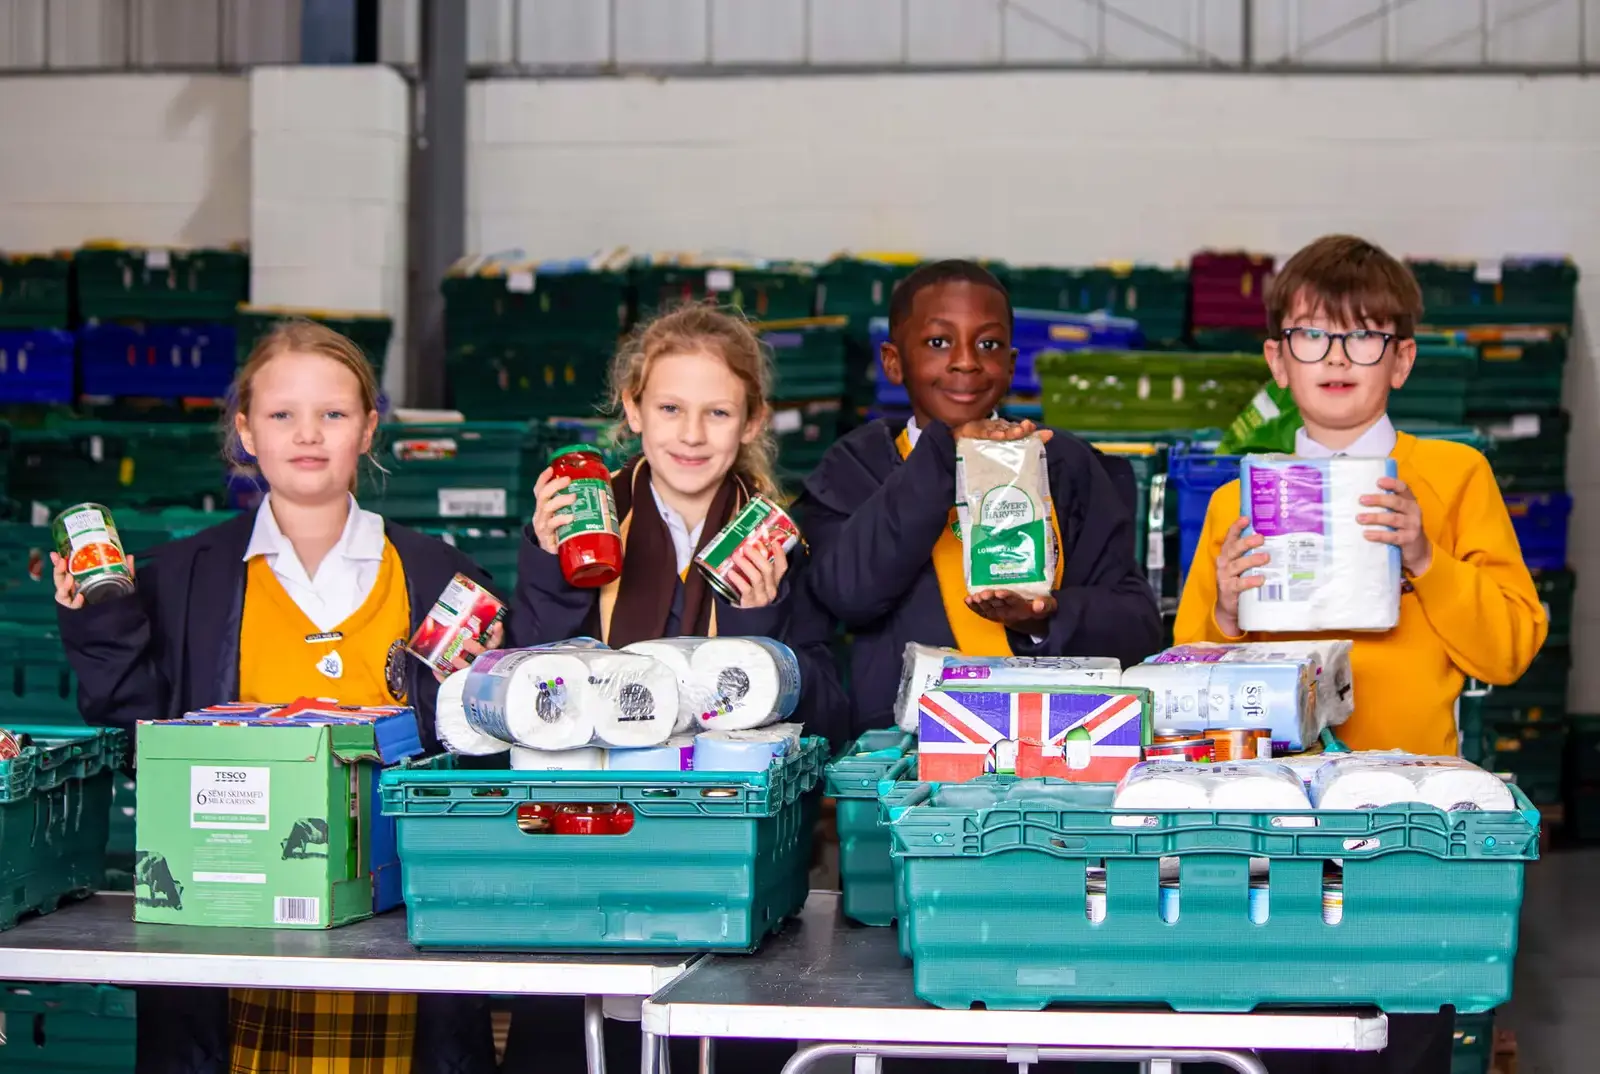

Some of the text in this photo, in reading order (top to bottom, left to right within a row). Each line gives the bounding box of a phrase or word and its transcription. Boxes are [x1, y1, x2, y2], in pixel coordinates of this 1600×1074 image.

[985, 510, 1025, 519] HARVEST
[1243, 686, 1264, 717] soft
[215, 771, 247, 780] TESCO
[196, 789, 264, 805] 6 SEMI SKIMMED
